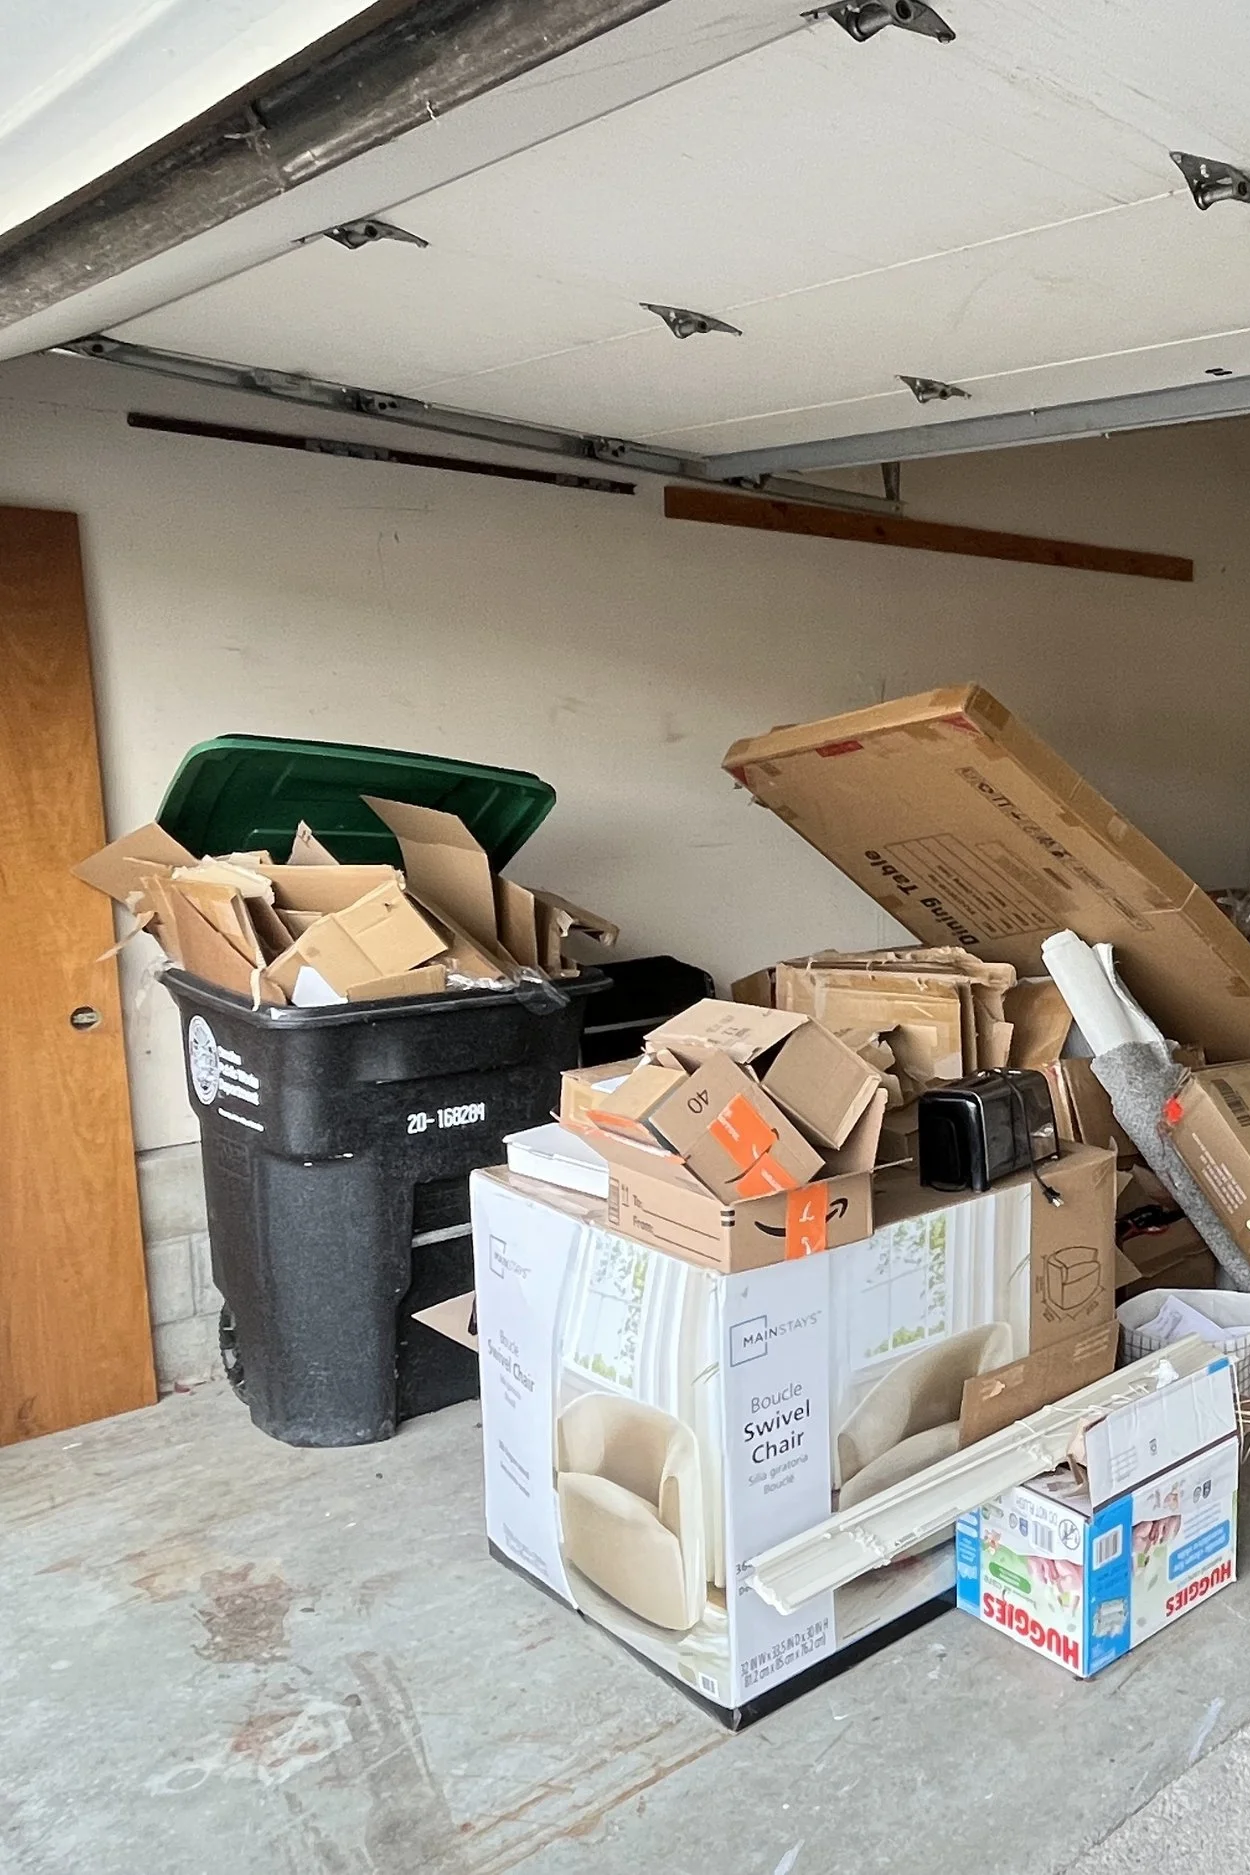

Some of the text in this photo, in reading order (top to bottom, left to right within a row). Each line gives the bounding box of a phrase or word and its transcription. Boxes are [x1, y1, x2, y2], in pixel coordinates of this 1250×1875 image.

[865, 850, 919, 896] Table
[920, 897, 980, 946] Dining
[687, 1089, 709, 1114] 40
[744, 1399, 810, 1443] Swivel
[751, 1383, 802, 1414] Boucle
[752, 1430, 804, 1464] Chair
[1166, 1560, 1232, 1617] HUGGIES
[983, 1592, 1079, 1670] HUGGIES
